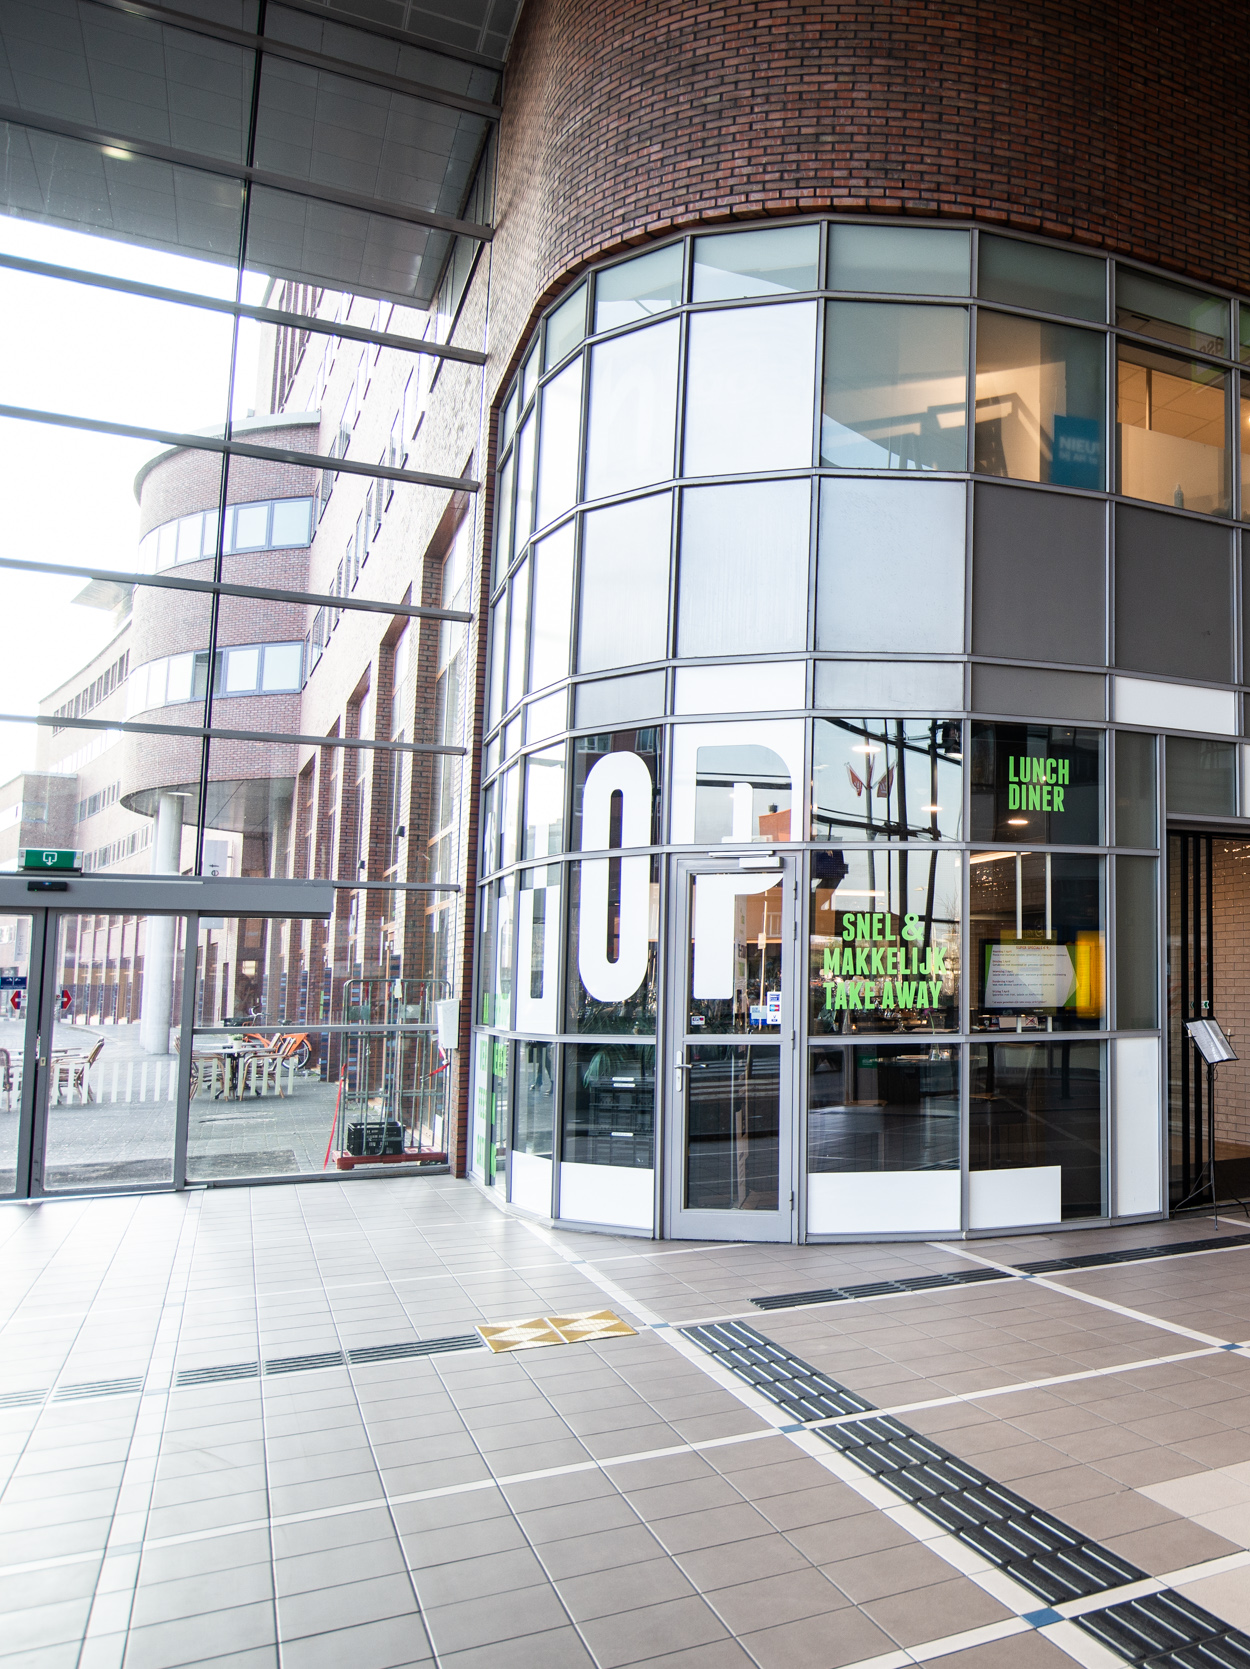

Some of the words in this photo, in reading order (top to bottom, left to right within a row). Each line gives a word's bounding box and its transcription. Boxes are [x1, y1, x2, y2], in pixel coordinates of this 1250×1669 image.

[1008, 755, 1070, 785] LUNCH
[1008, 783, 1065, 812] DINER
[842, 912, 897, 942] SNEL
[901, 912, 925, 942] &
[823, 946, 948, 976] MAKKELIJK
[822, 980, 876, 1010] TAKE
[881, 980, 943, 1009] AWAY
